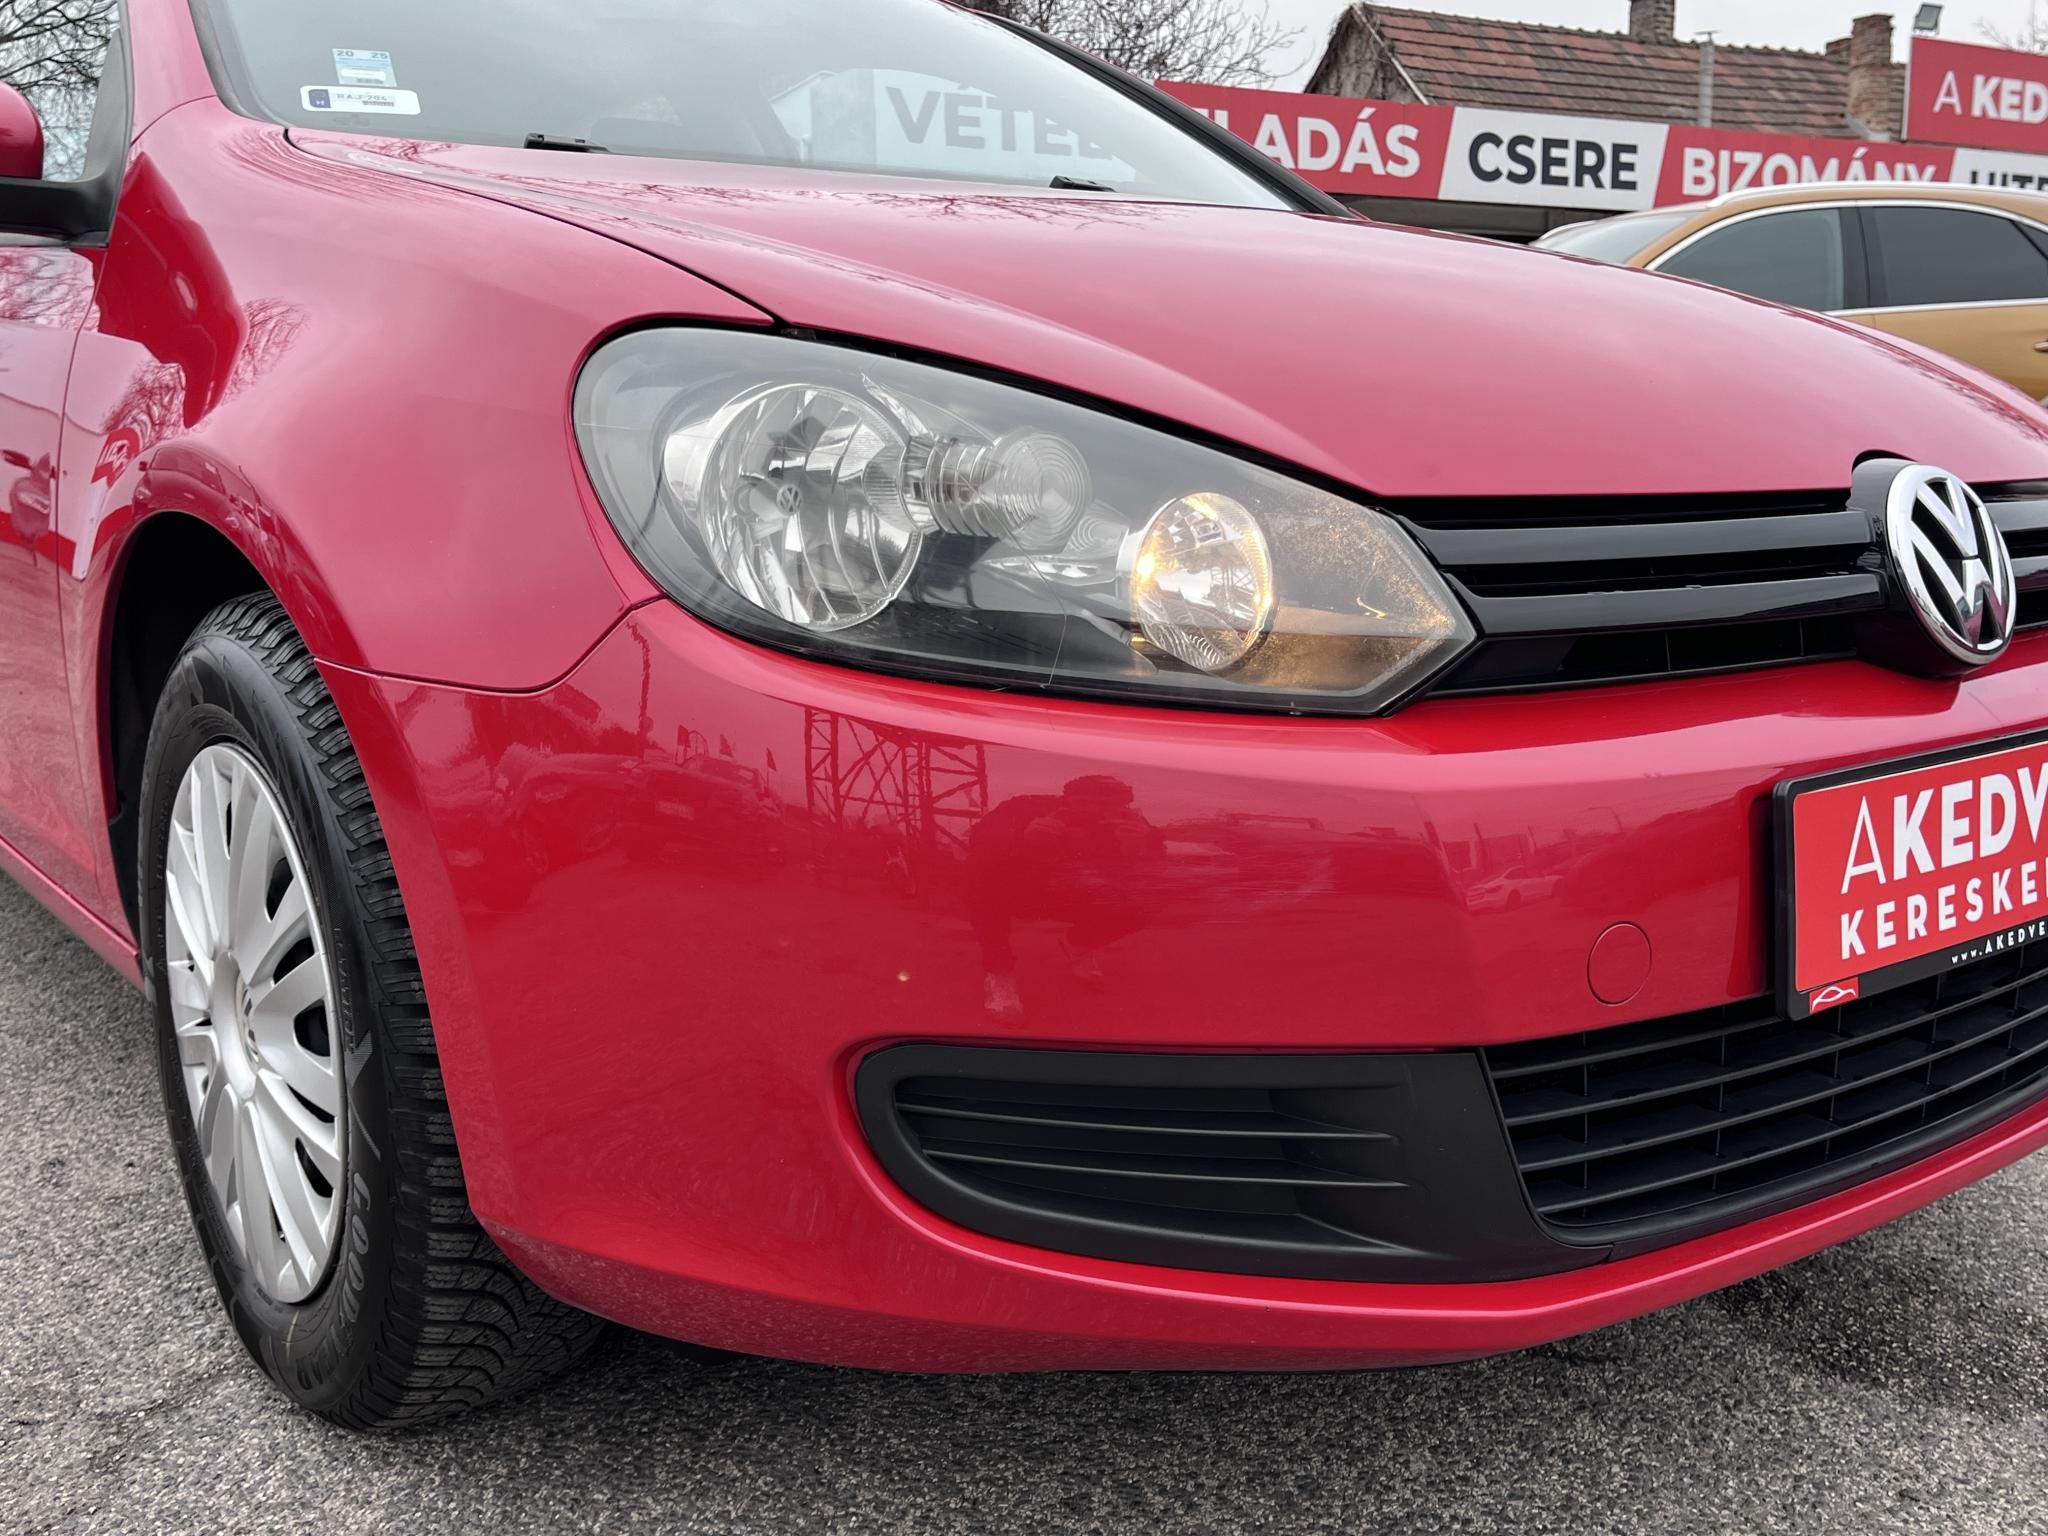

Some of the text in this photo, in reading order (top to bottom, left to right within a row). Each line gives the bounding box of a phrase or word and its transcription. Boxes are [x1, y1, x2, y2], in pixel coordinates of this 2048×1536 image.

[1932, 71, 2048, 124] A KED
[1191, 106, 1421, 178] ADÁS
[1468, 131, 1640, 191] CSERE
[1840, 856, 2048, 961] KERESKE
